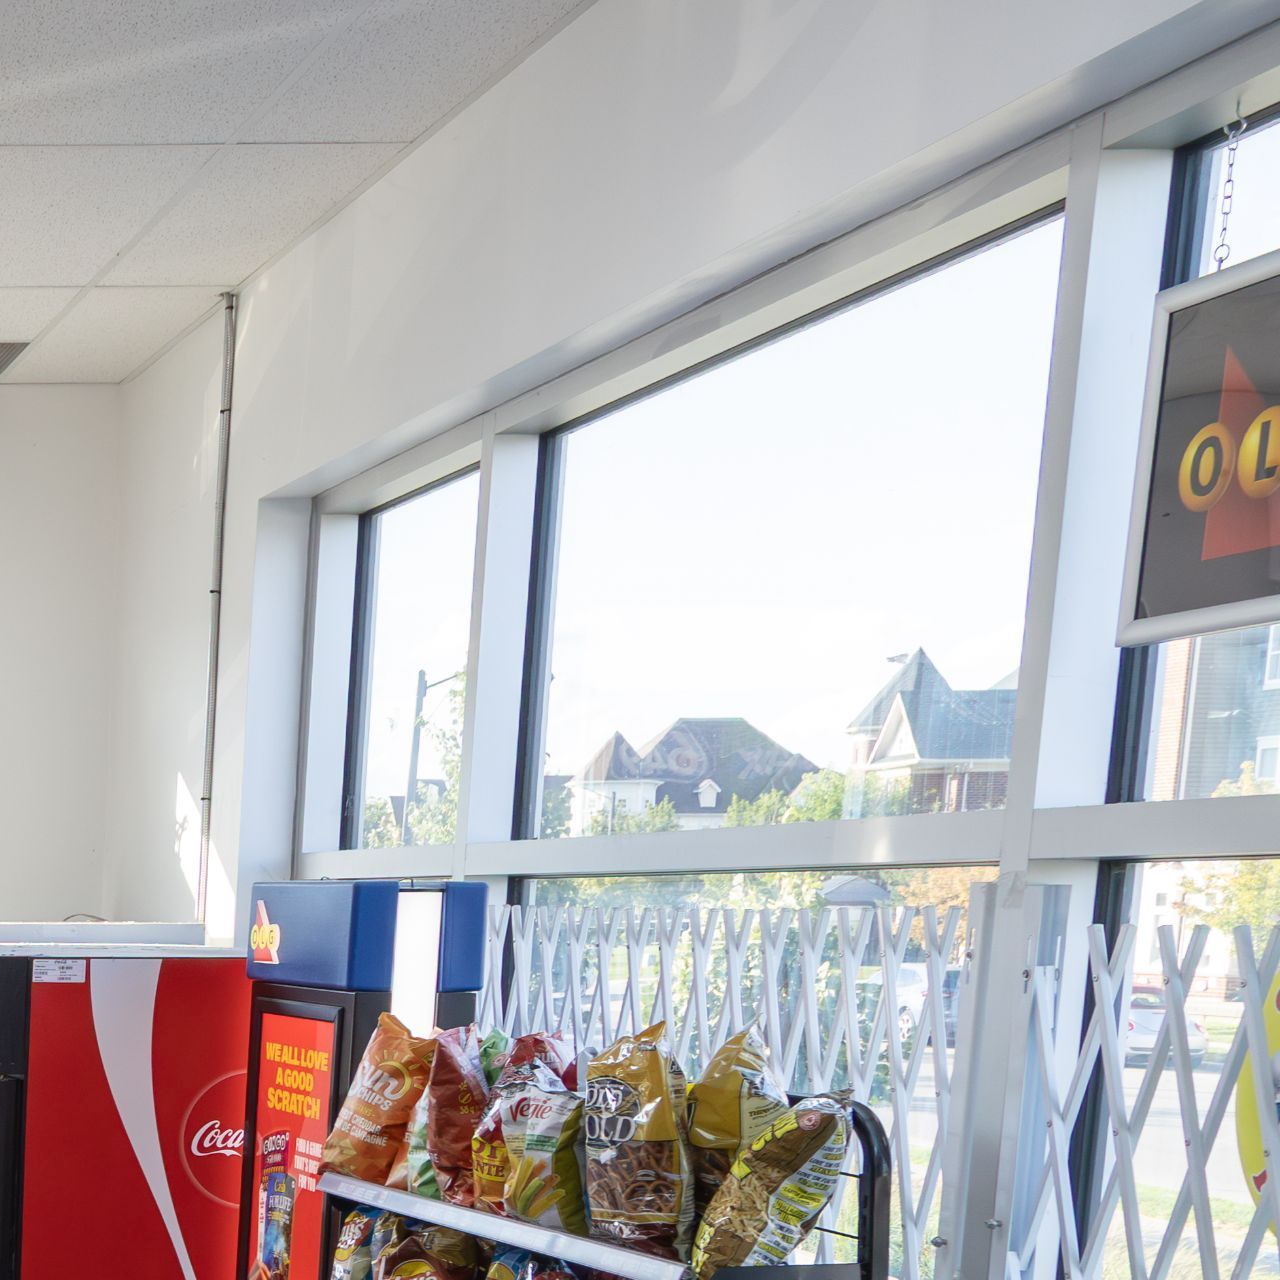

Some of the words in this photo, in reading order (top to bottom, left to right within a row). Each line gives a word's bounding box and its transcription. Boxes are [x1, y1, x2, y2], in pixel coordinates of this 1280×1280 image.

[252, 928, 276, 945] OLG
[266, 1042, 282, 1061] WE
[281, 1044, 301, 1066] ALL
[301, 1049, 329, 1072] LOVE
[276, 1067, 283, 1085] A
[283, 1069, 314, 1092] GOOD
[267, 1087, 321, 1120] SCRATCH
[359, 1086, 392, 1111] CHIPS
